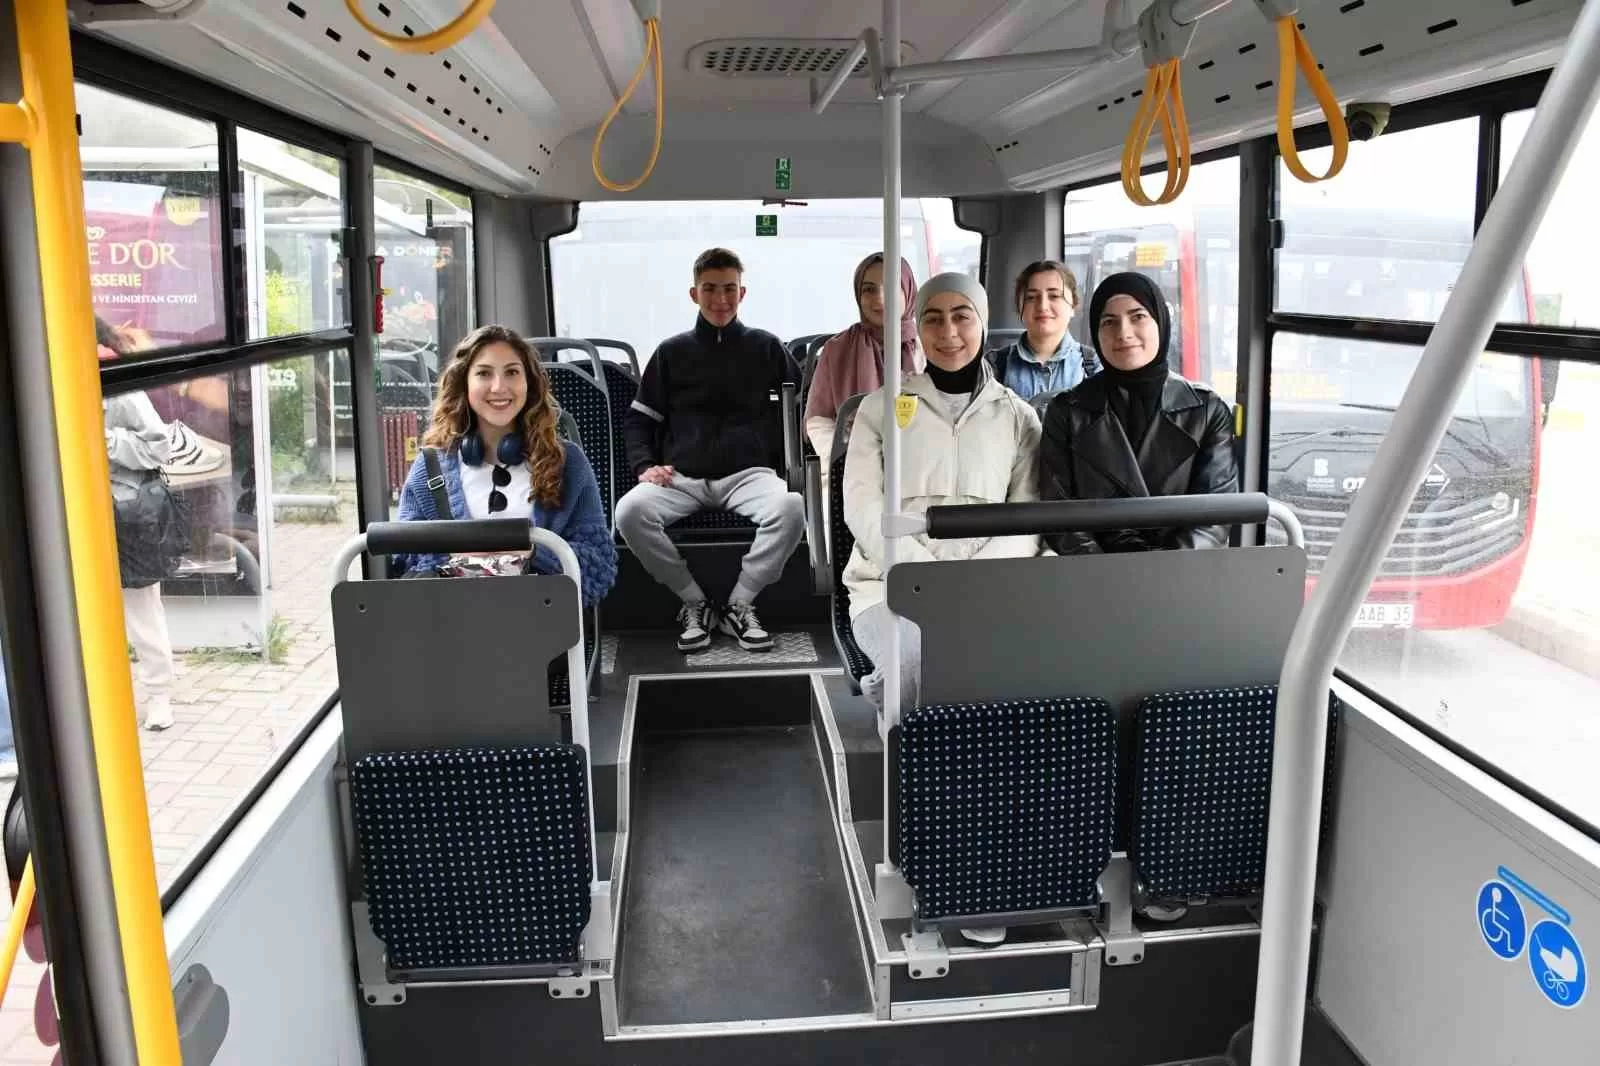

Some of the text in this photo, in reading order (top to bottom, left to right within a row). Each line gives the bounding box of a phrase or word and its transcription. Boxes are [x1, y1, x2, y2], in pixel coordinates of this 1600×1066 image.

[87, 239, 189, 271] E D'OR
[91, 273, 142, 288] SSERIE
